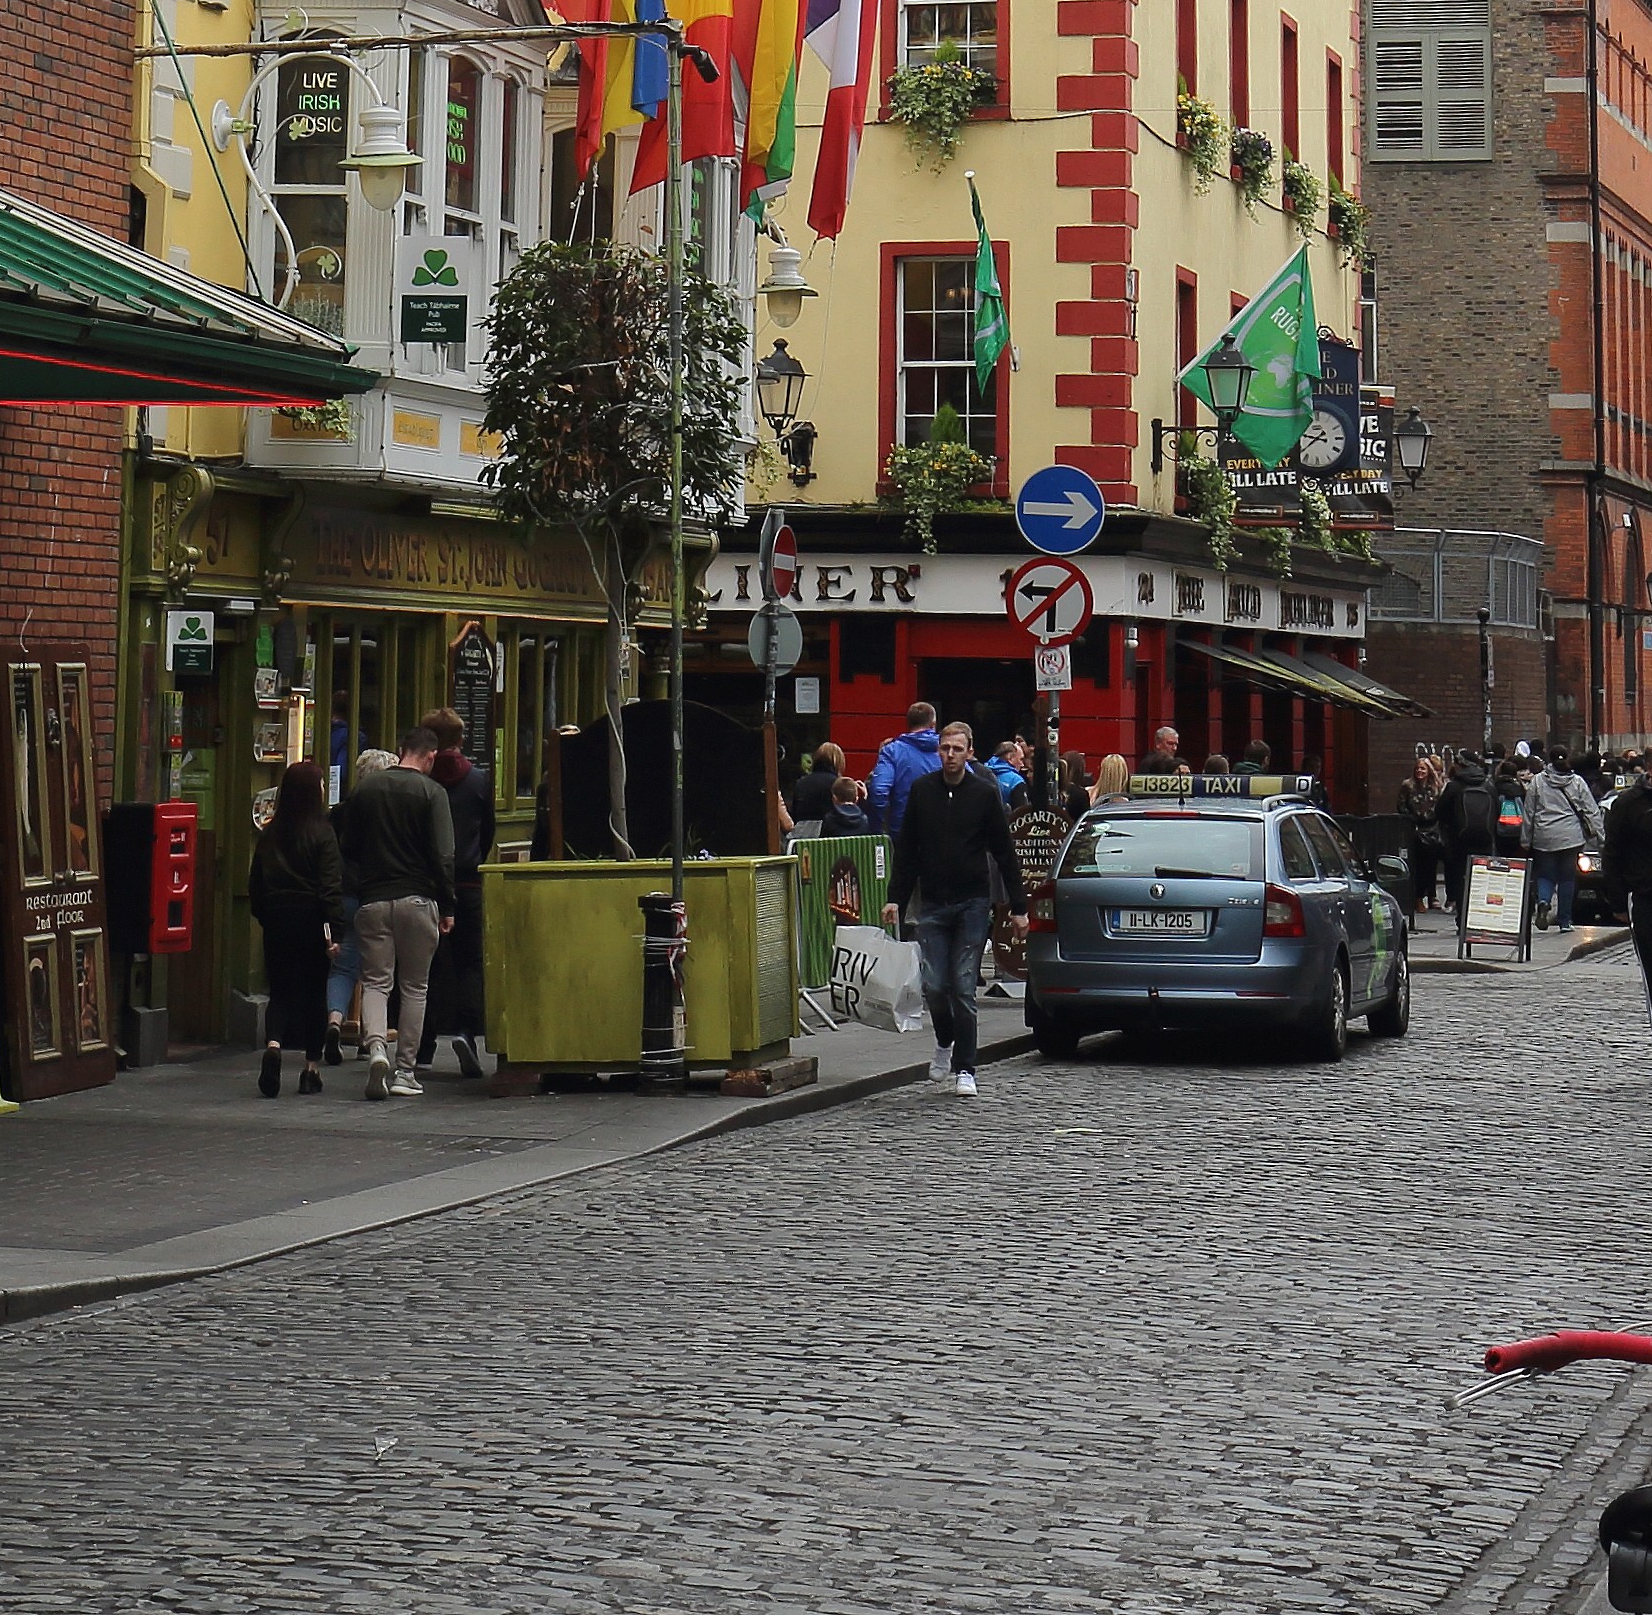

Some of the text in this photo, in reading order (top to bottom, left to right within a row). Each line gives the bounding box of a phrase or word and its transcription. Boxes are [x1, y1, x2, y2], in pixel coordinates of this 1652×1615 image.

[302, 72, 338, 89] LIVE
[298, 95, 341, 111] IRISH
[1270, 306, 1300, 342] RUG
[1256, 471, 1298, 487] LATE
[1354, 481, 1389, 496] LATE
[314, 515, 351, 578] THE
[358, 522, 431, 583] OLIVER
[1143, 777, 1190, 793] 13823
[1202, 776, 1241, 794] TAXI
[1009, 810, 1069, 834] GOGARTY'S
[1130, 912, 1193, 929] 11-LK-1205
[832, 945, 879, 987] RIV
[830, 980, 862, 1020] ER
